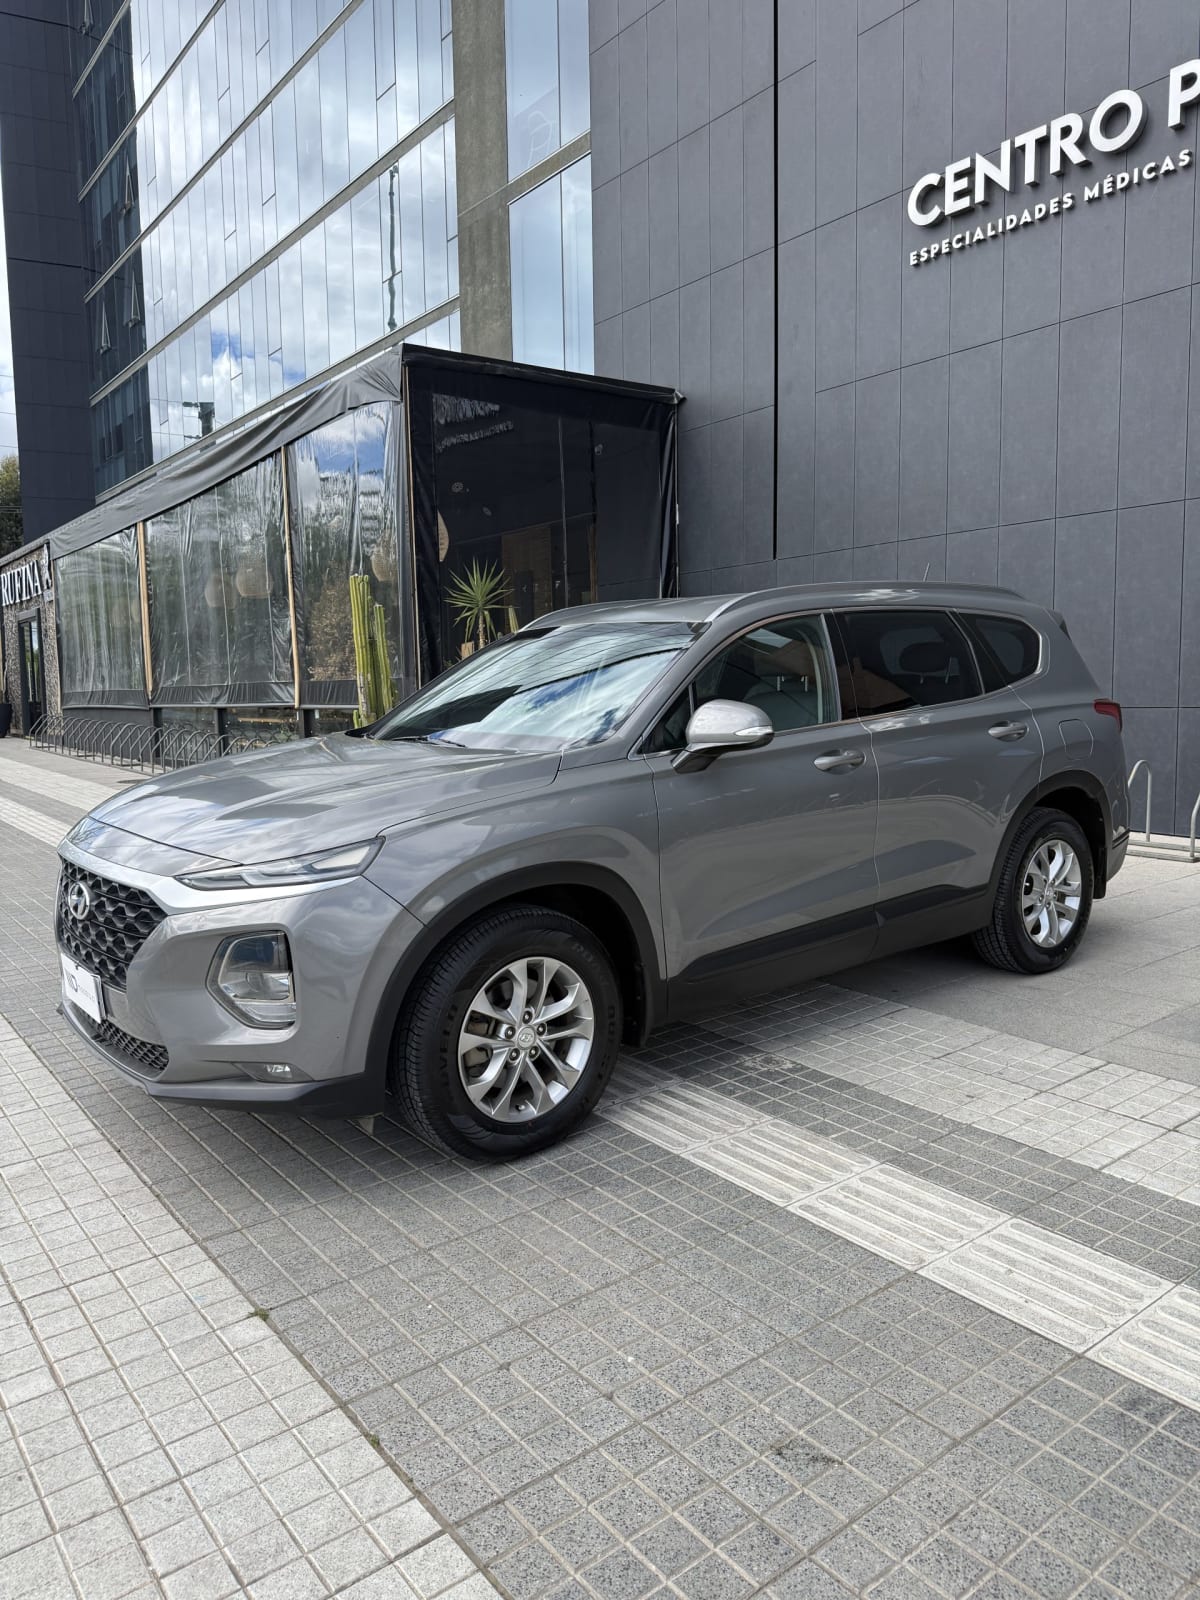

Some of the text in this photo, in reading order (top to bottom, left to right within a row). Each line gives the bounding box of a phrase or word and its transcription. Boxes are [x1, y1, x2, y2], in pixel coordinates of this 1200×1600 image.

[907, 89, 1145, 227] CENTRO
[909, 149, 1193, 266] ESPECIALIDADES MÉDICAS
[1, 559, 42, 607] RUFINA
